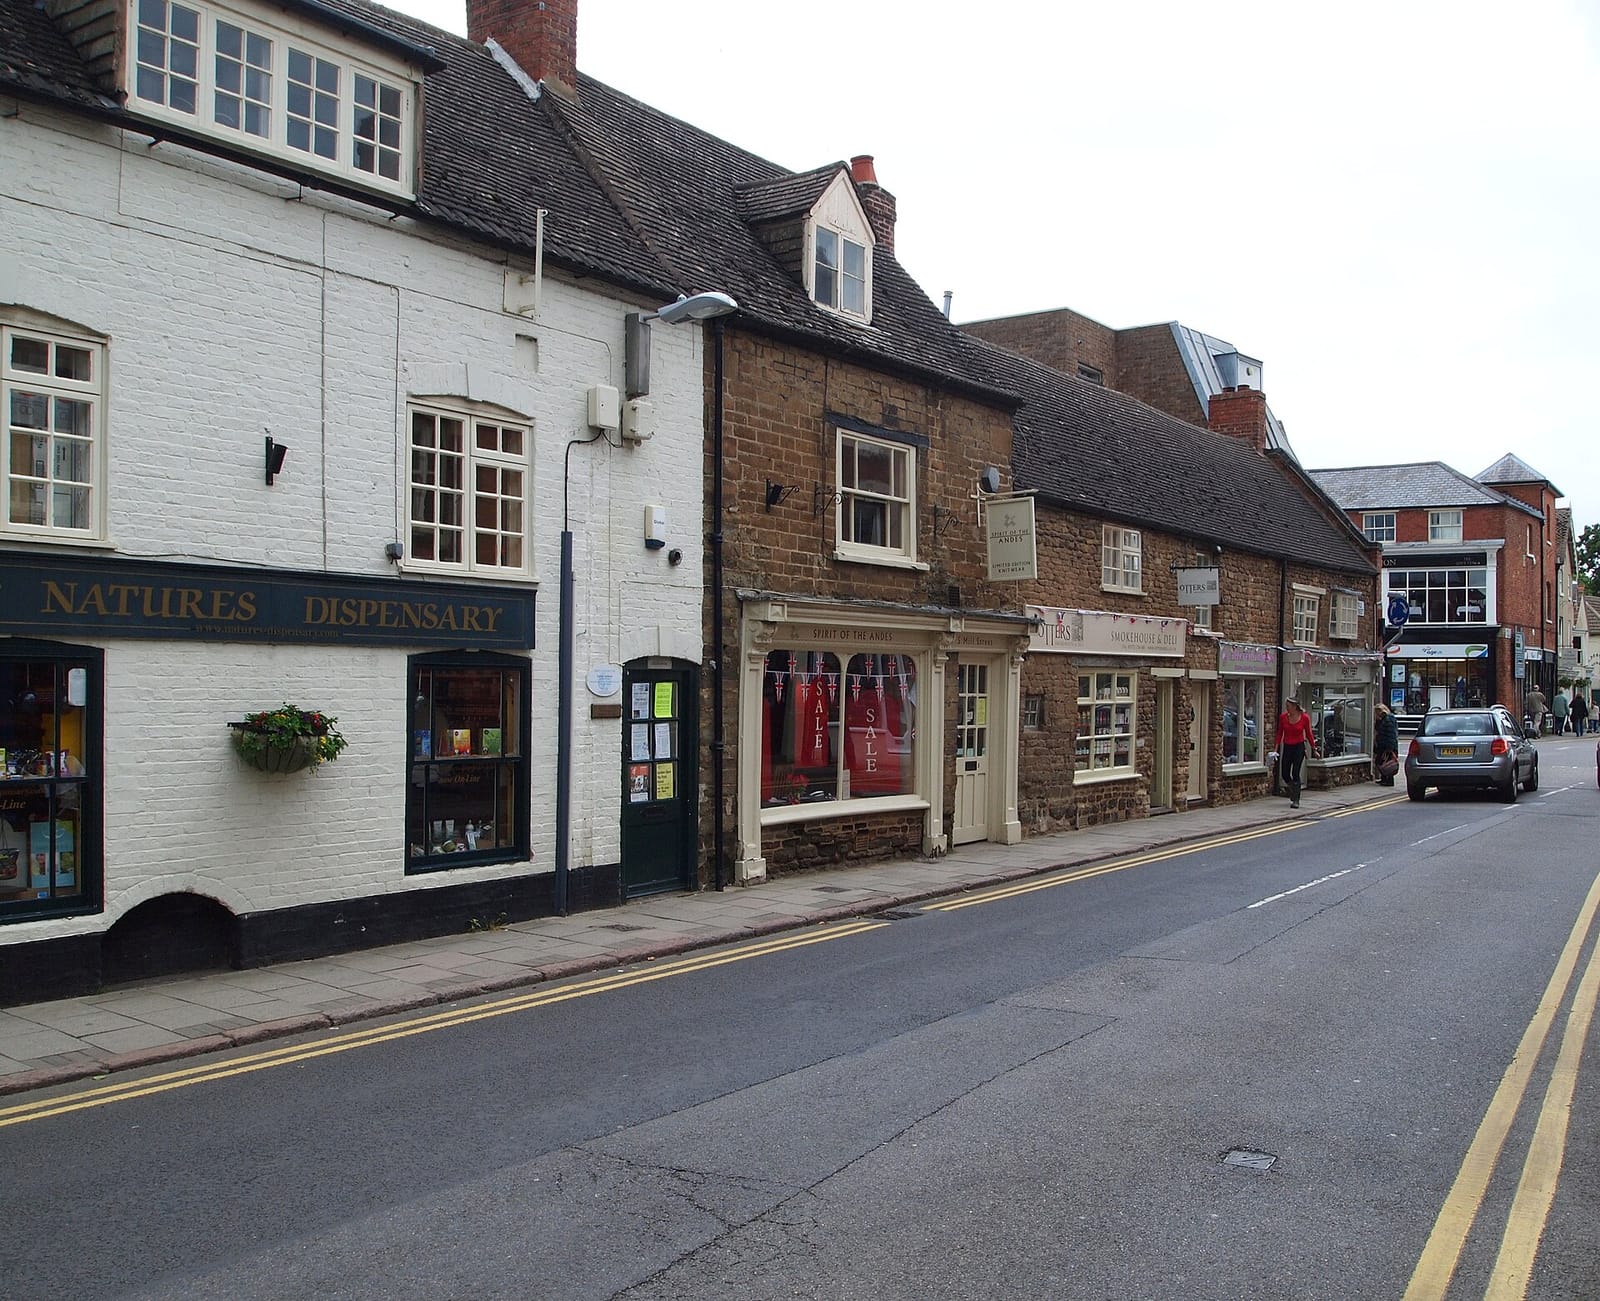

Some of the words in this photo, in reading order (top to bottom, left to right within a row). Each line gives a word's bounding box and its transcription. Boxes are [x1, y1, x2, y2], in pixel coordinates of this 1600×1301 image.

[998, 535, 1023, 544] ANDES
[1179, 584, 1207, 594] OTTERS
[40, 580, 257, 621] NATURES
[303, 595, 504, 632] DISPENSARY
[812, 628, 837, 640] SPIRIT
[840, 629, 850, 640] OF
[852, 630, 867, 641] THE
[869, 631, 893, 642] ANDES
[1110, 630, 1155, 645] SMOKEHOUSE
[1156, 633, 1162, 644] &
[1163, 634, 1177, 645] DELI
[814, 681, 823, 749] SALE
[864, 708, 878, 773] SALE
